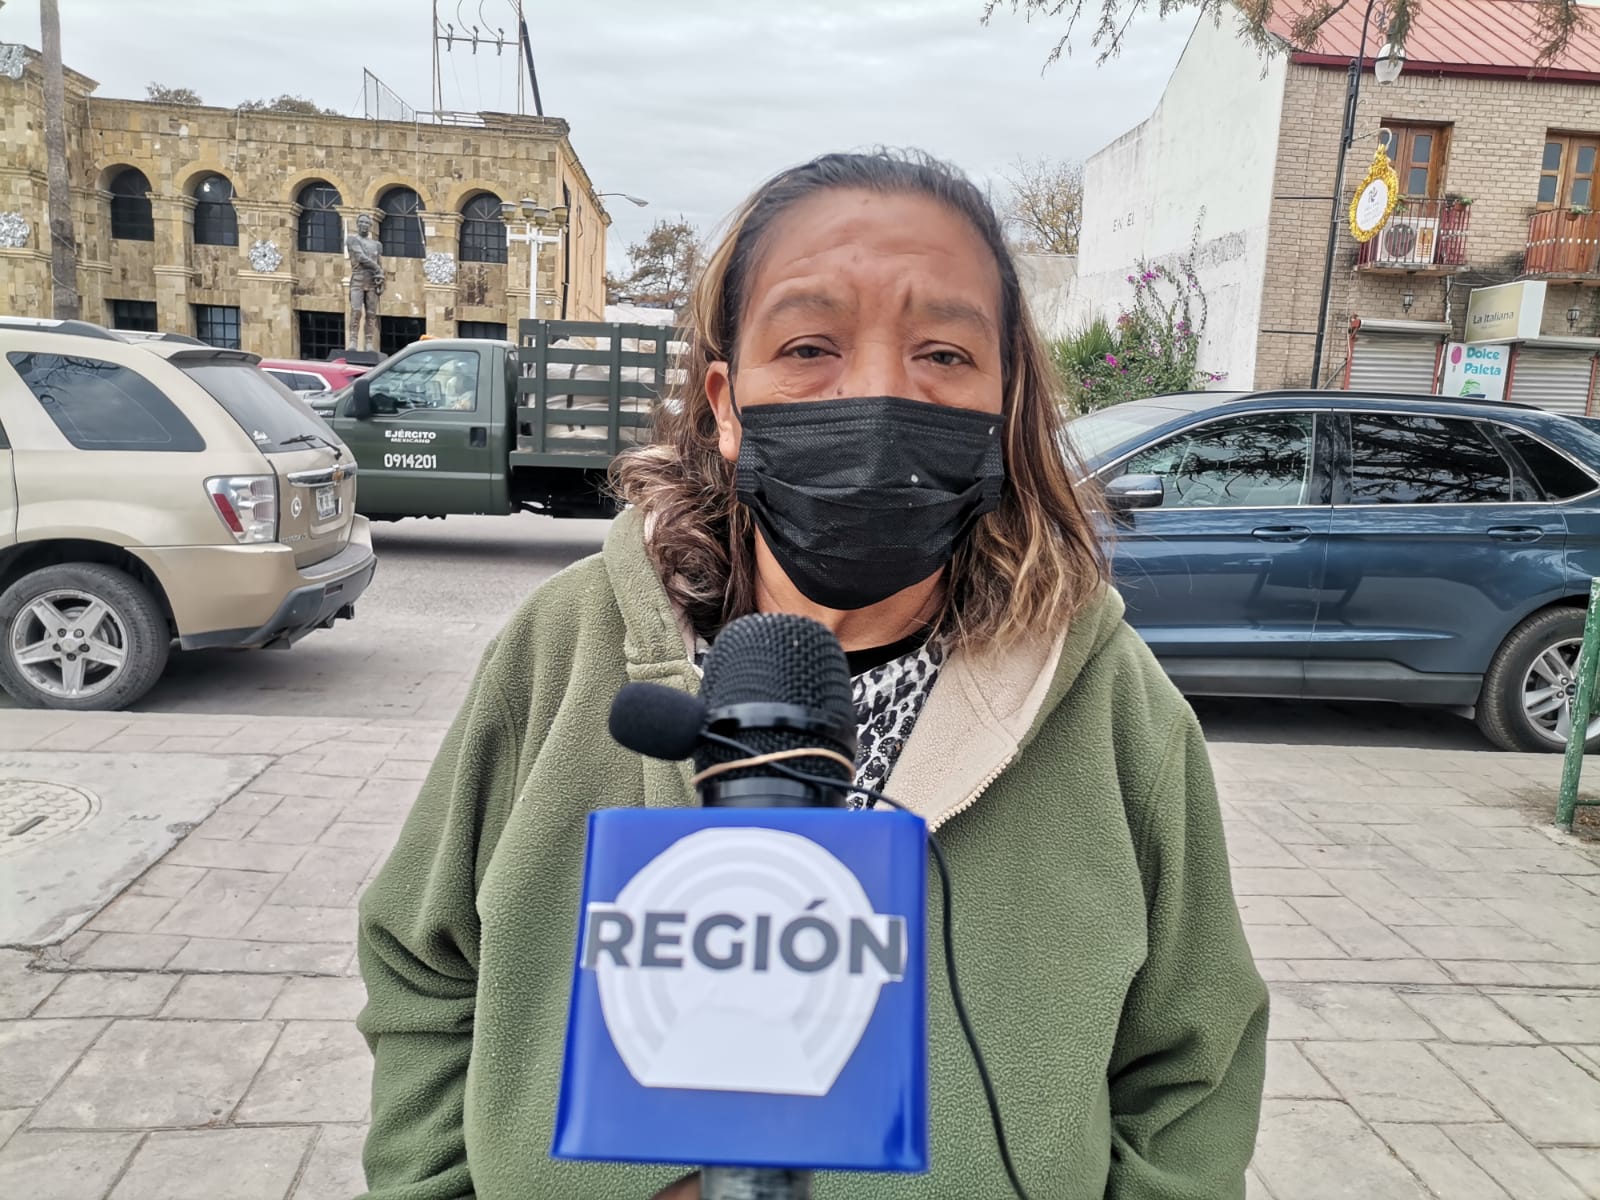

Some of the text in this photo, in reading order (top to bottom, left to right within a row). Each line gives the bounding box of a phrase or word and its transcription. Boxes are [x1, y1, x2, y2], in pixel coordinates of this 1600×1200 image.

[1472, 311, 1514, 325] La Italiana
[1466, 347, 1500, 360] Dolce
[1464, 363, 1502, 376] Paleta
[384, 429, 437, 439] EJÉRCITO
[384, 453, 437, 469] 0914201
[586, 899, 903, 976] REGIÓN
